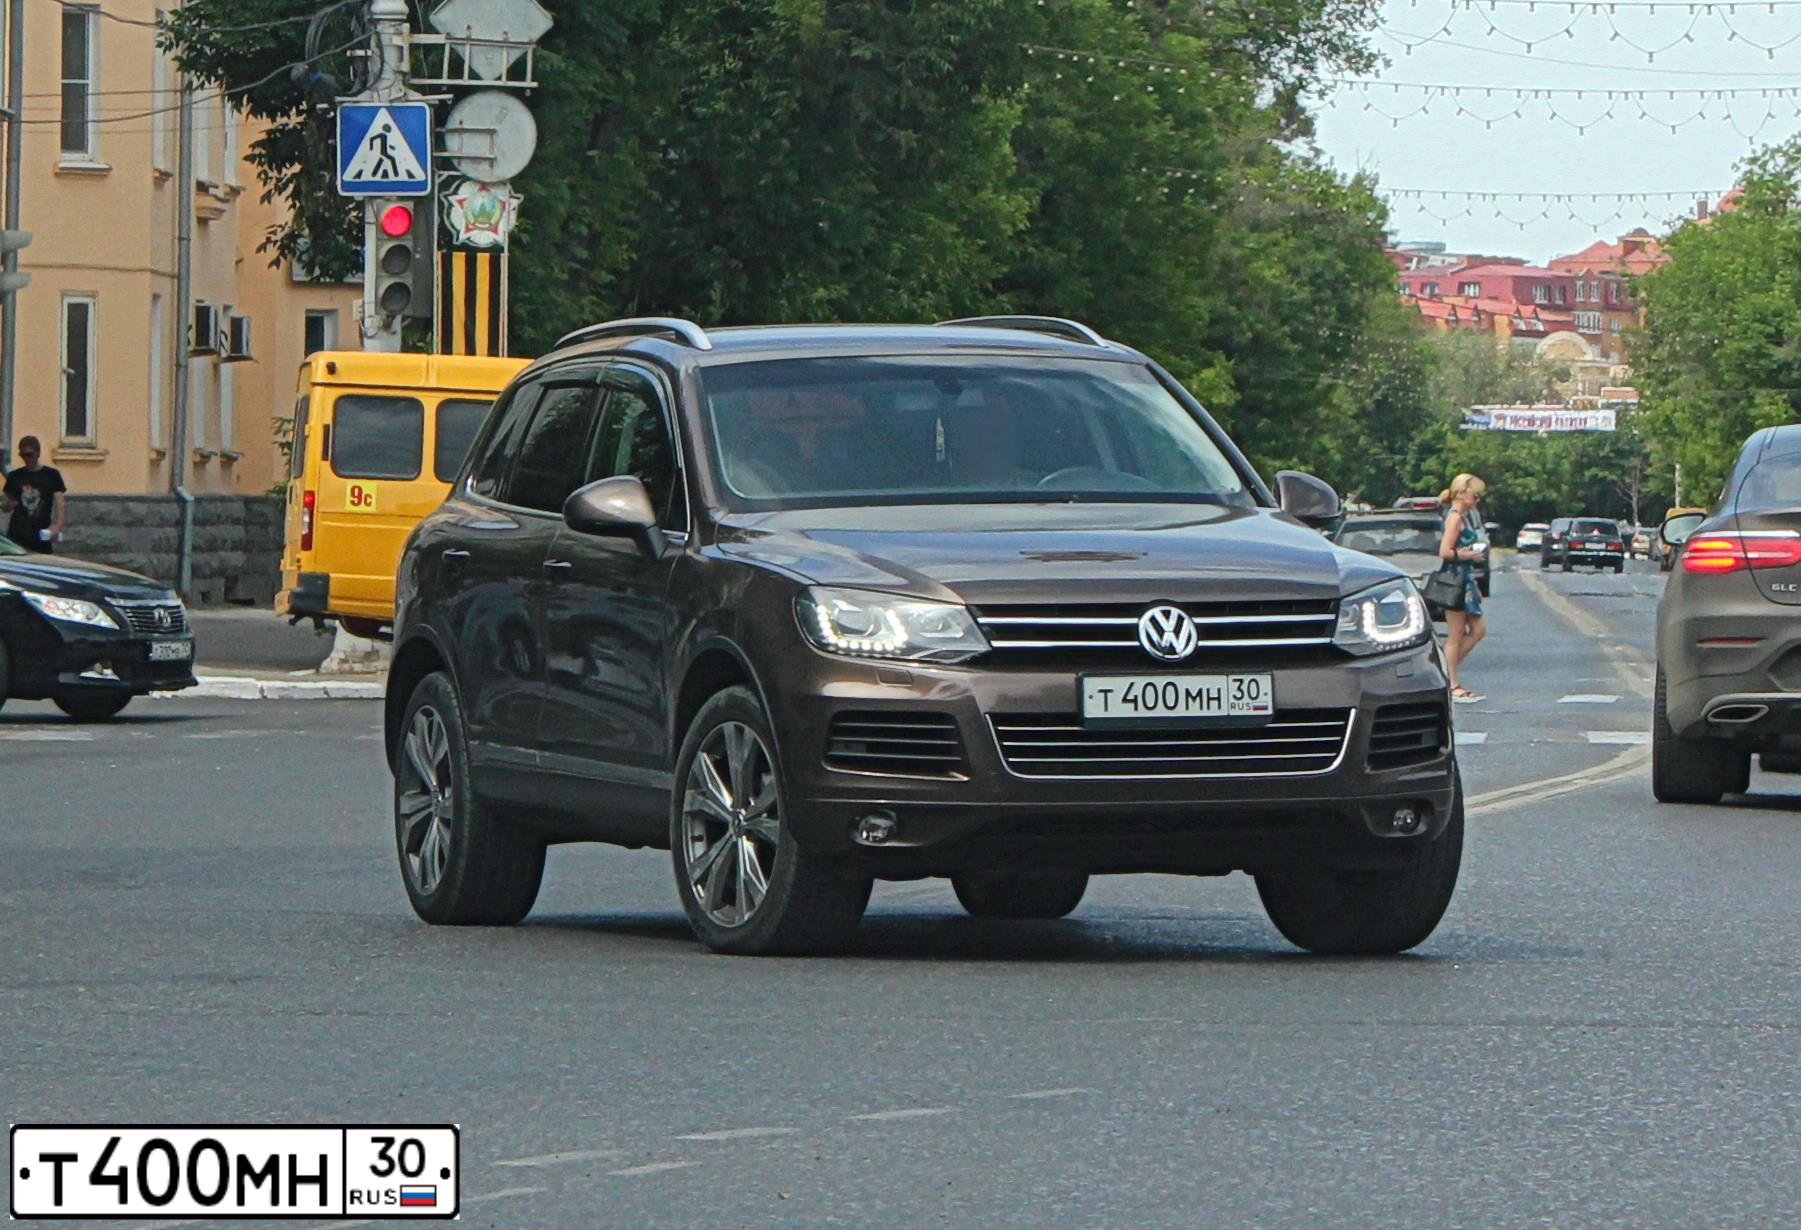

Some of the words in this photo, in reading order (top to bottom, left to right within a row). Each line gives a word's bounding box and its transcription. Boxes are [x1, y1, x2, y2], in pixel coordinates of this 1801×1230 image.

[1771, 583, 1798, 592] GLC
[1231, 678, 1260, 701] 30
[1230, 702, 1251, 711] RUS
